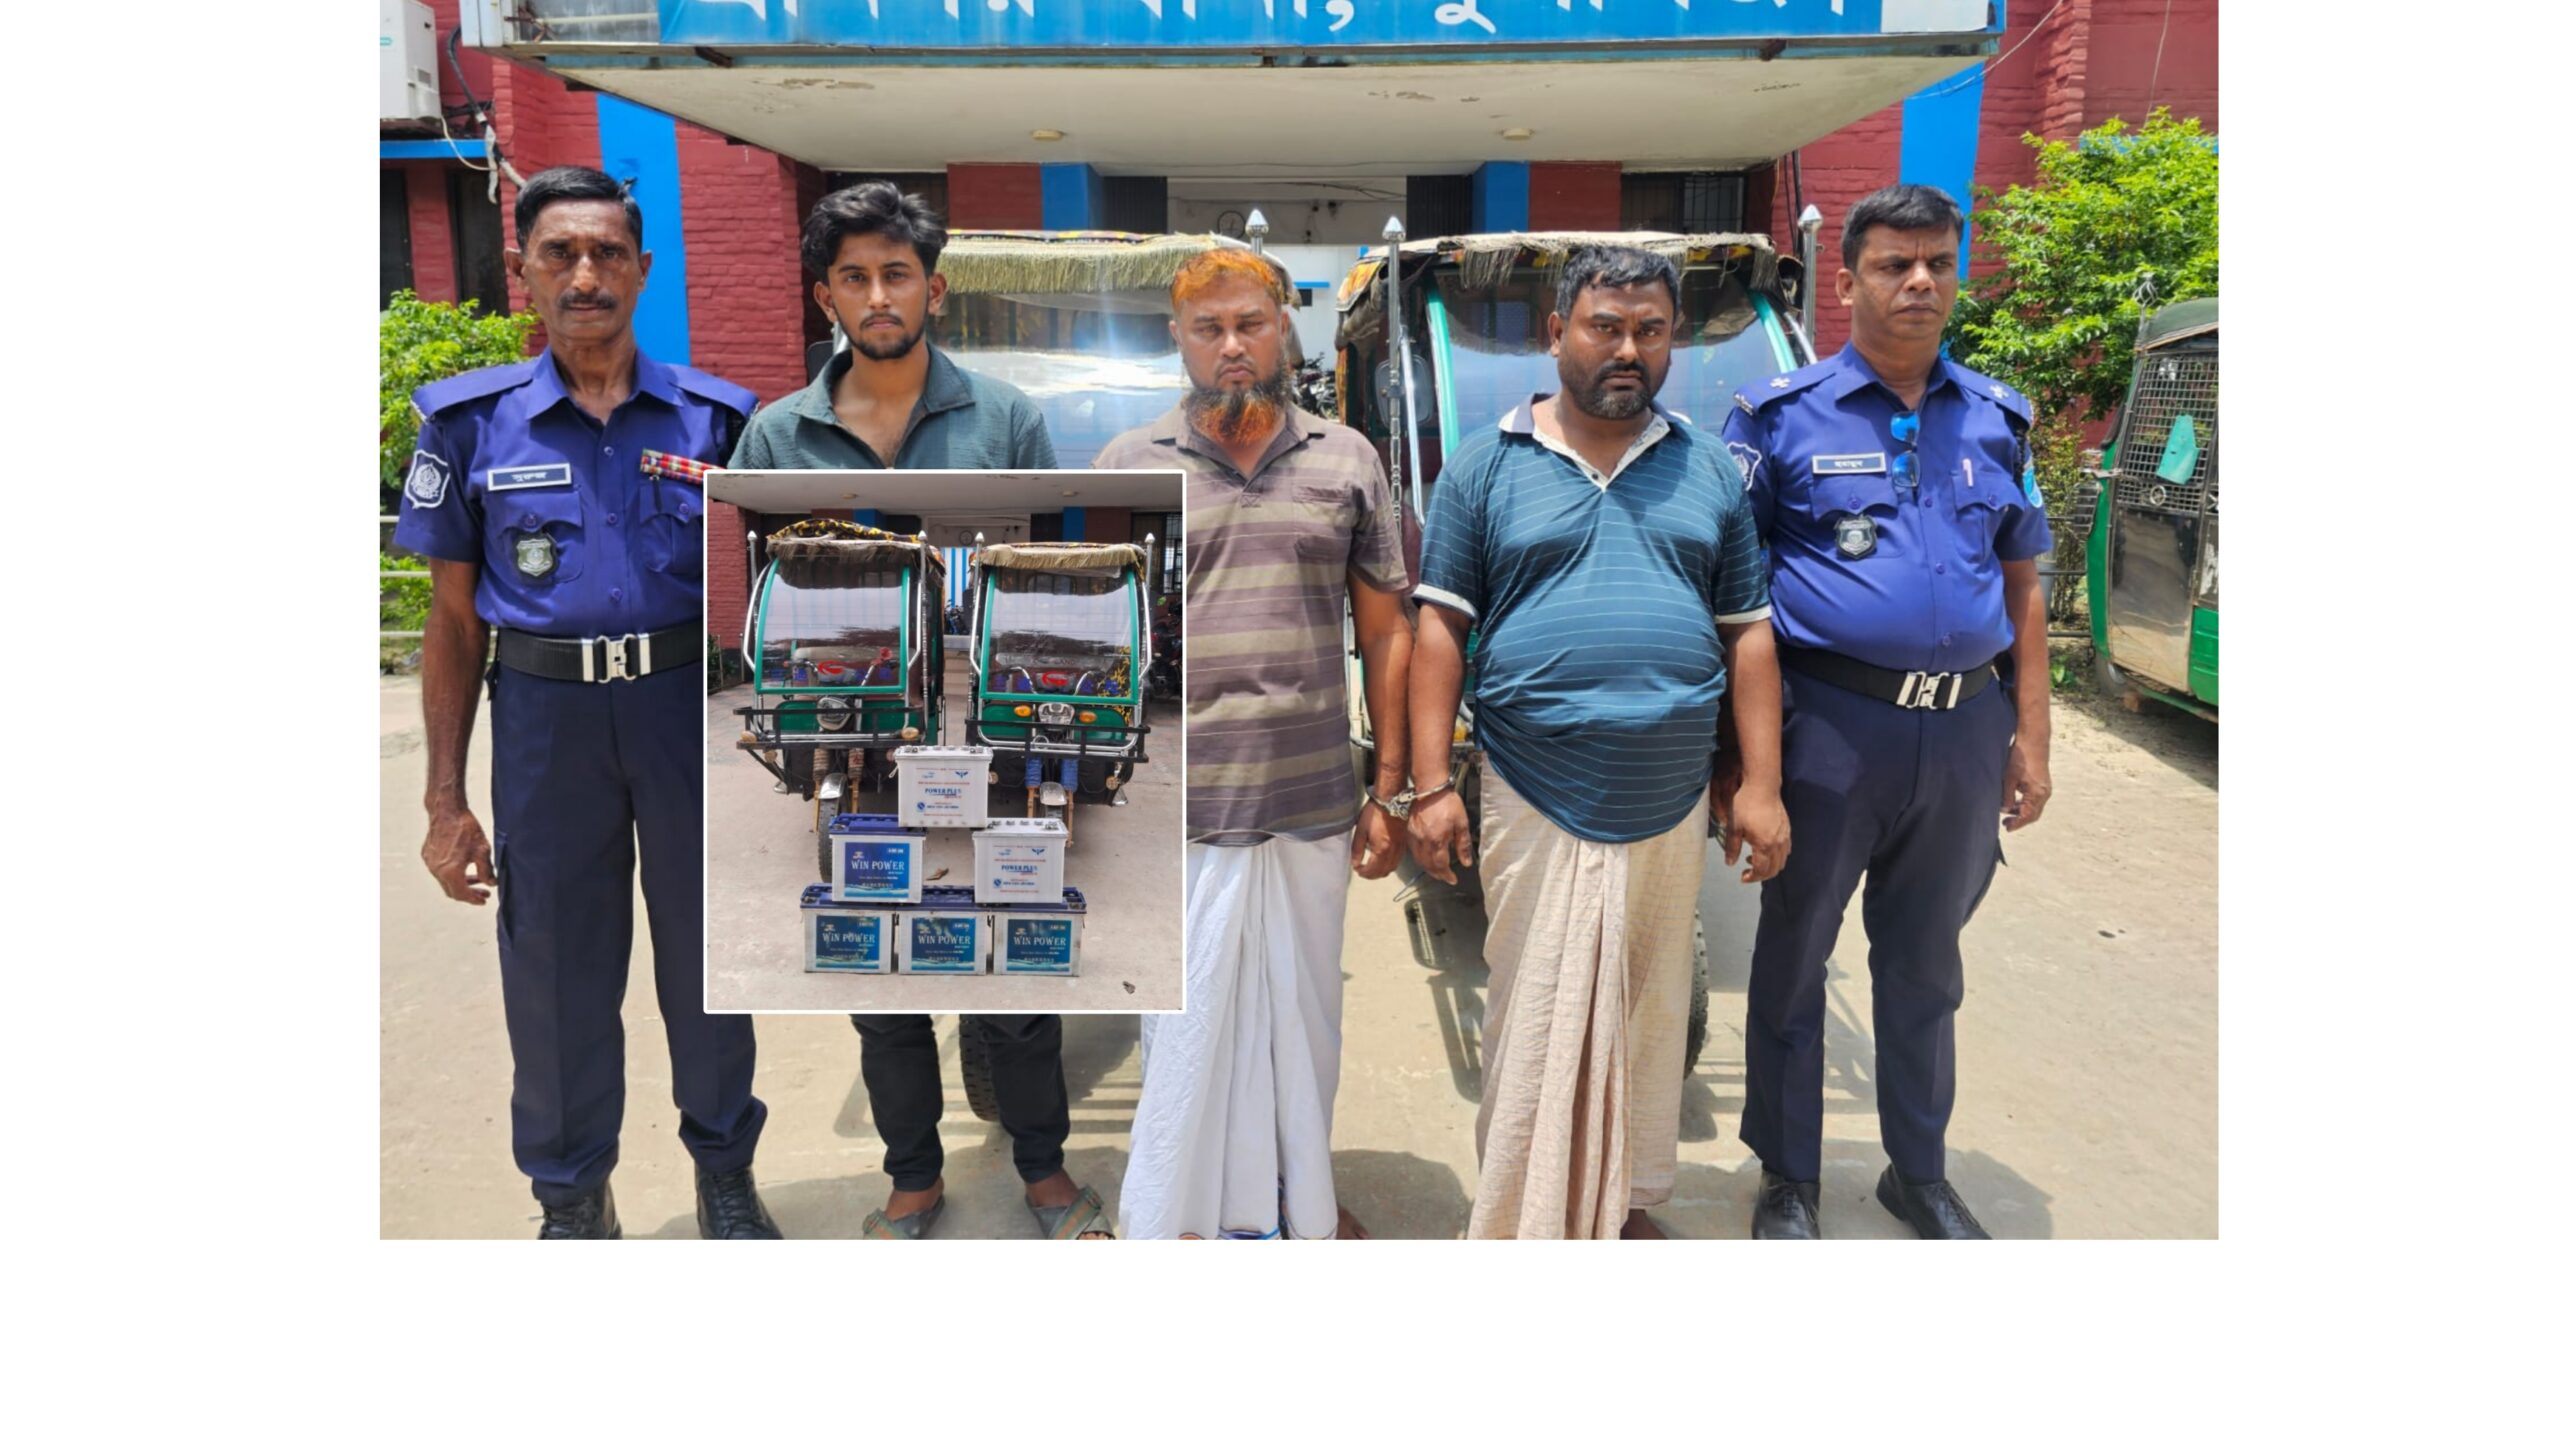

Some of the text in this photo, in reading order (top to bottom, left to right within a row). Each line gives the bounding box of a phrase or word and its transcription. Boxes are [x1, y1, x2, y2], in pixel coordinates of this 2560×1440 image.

[851, 859, 905, 870] WIN POWER
[822, 932, 876, 943] WIN POWER
[918, 934, 971, 945] WIN POWER
[1013, 936, 1067, 946] WIN POWER
